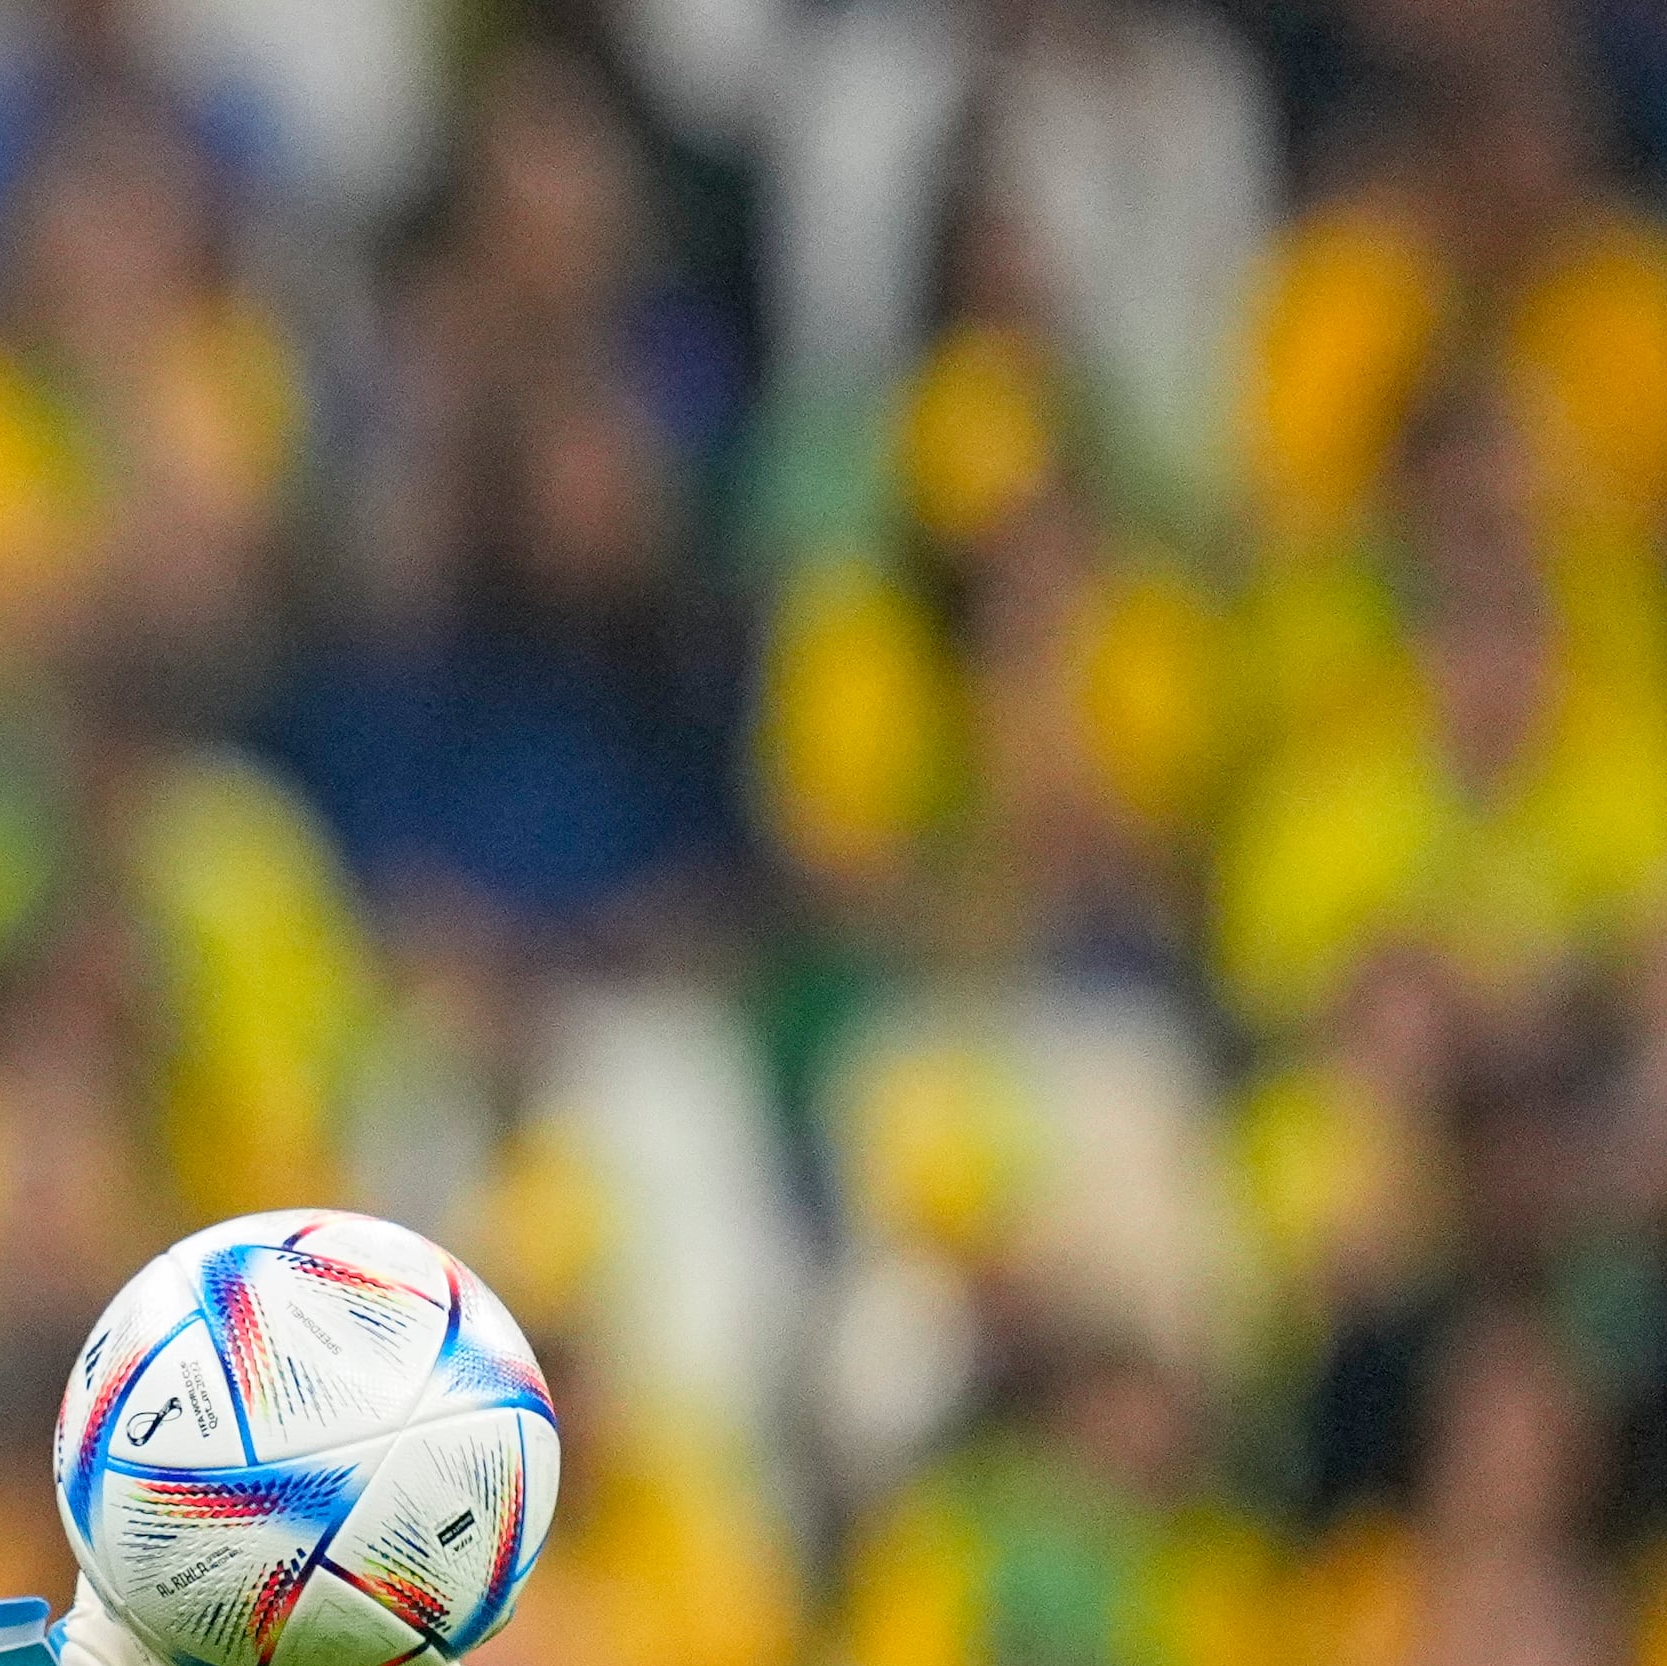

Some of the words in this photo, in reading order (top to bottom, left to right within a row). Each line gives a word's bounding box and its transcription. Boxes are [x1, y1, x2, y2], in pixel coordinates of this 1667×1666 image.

[286, 1300, 342, 1355] SPEEDSHELL
[185, 1380, 202, 1416] WORLD
[197, 1415, 210, 1438] FIFA
[156, 1581, 175, 1598] AL
[171, 1561, 210, 1591] RIHLA
